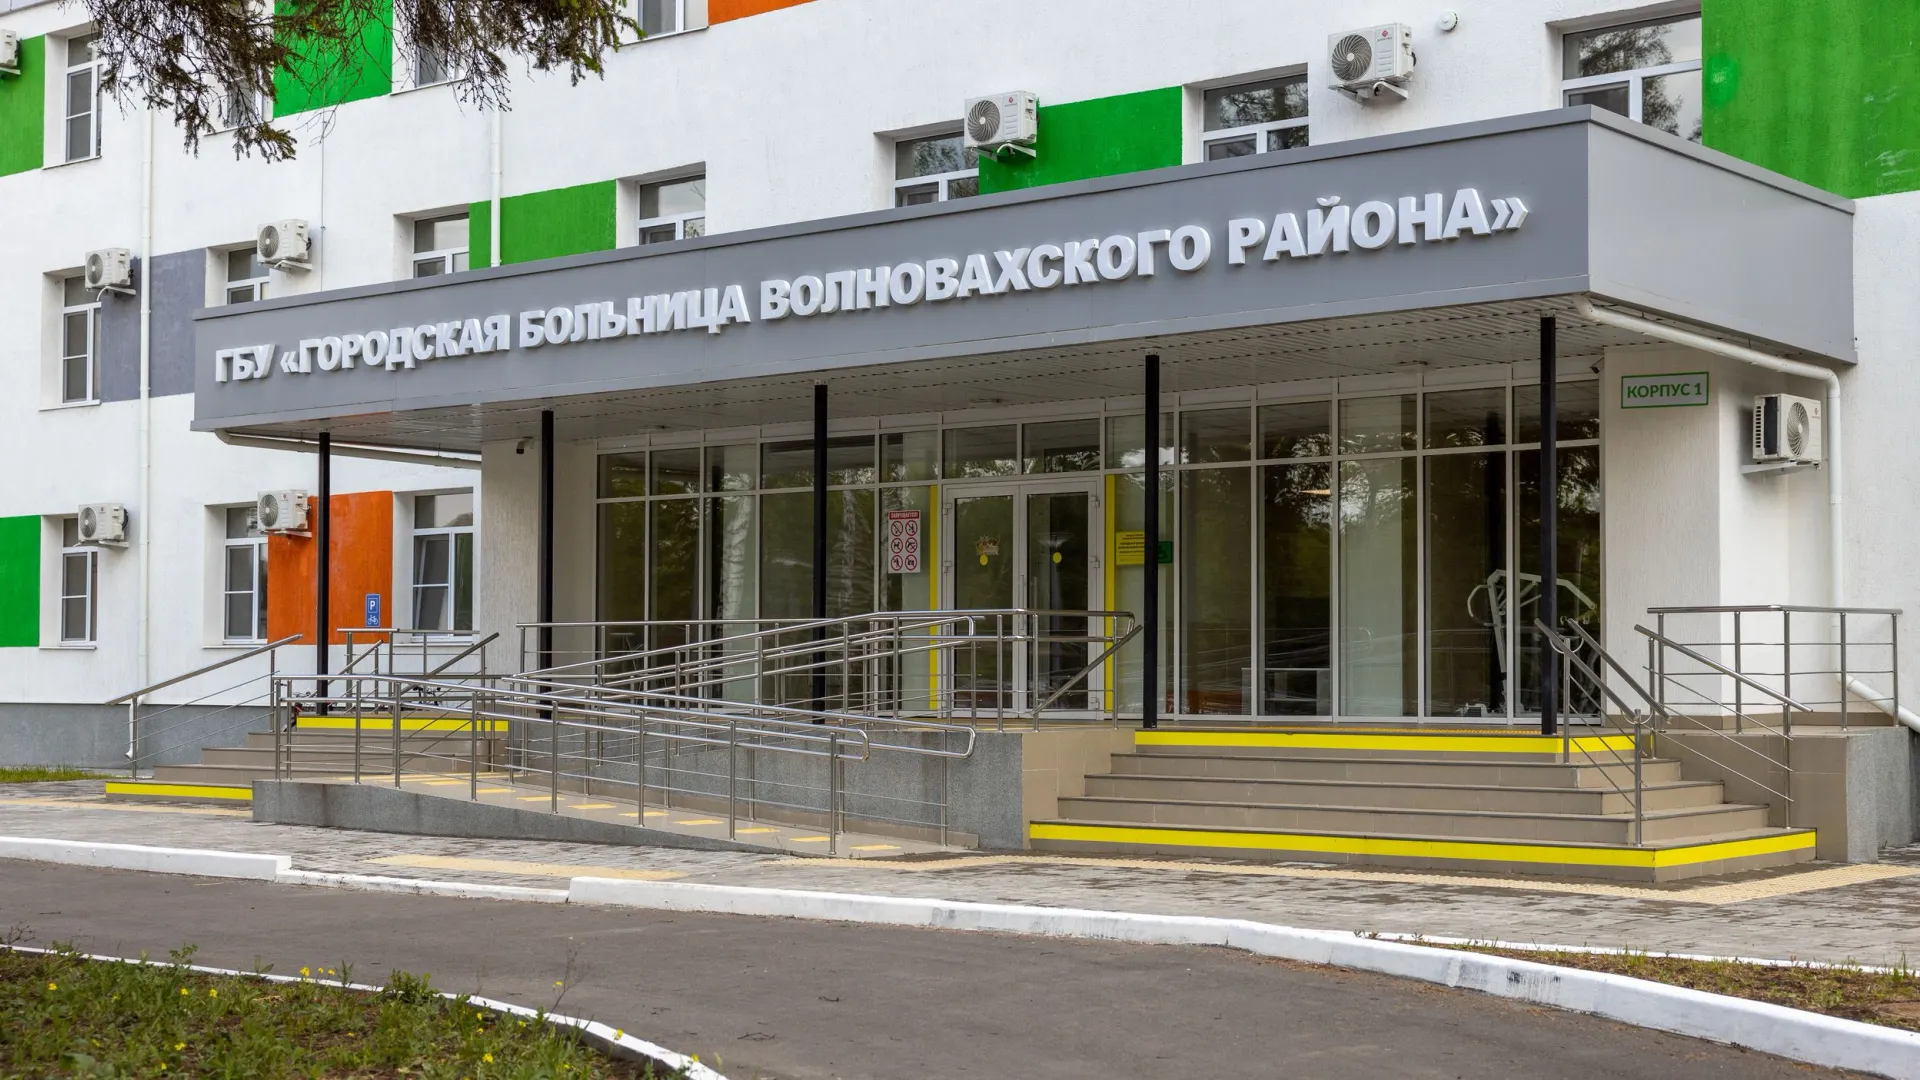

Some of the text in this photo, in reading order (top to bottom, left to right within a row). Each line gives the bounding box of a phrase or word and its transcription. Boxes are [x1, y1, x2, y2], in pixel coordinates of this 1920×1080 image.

[215, 188, 1529, 382] ГБУ «ГОРОДСКАЯ БОЛЬНИЦА ВОЛНОВАХСКОГО РАЙОНА»
[1627, 382, 1702, 398] КОРПУС 1
[370, 600, 376, 610] P
